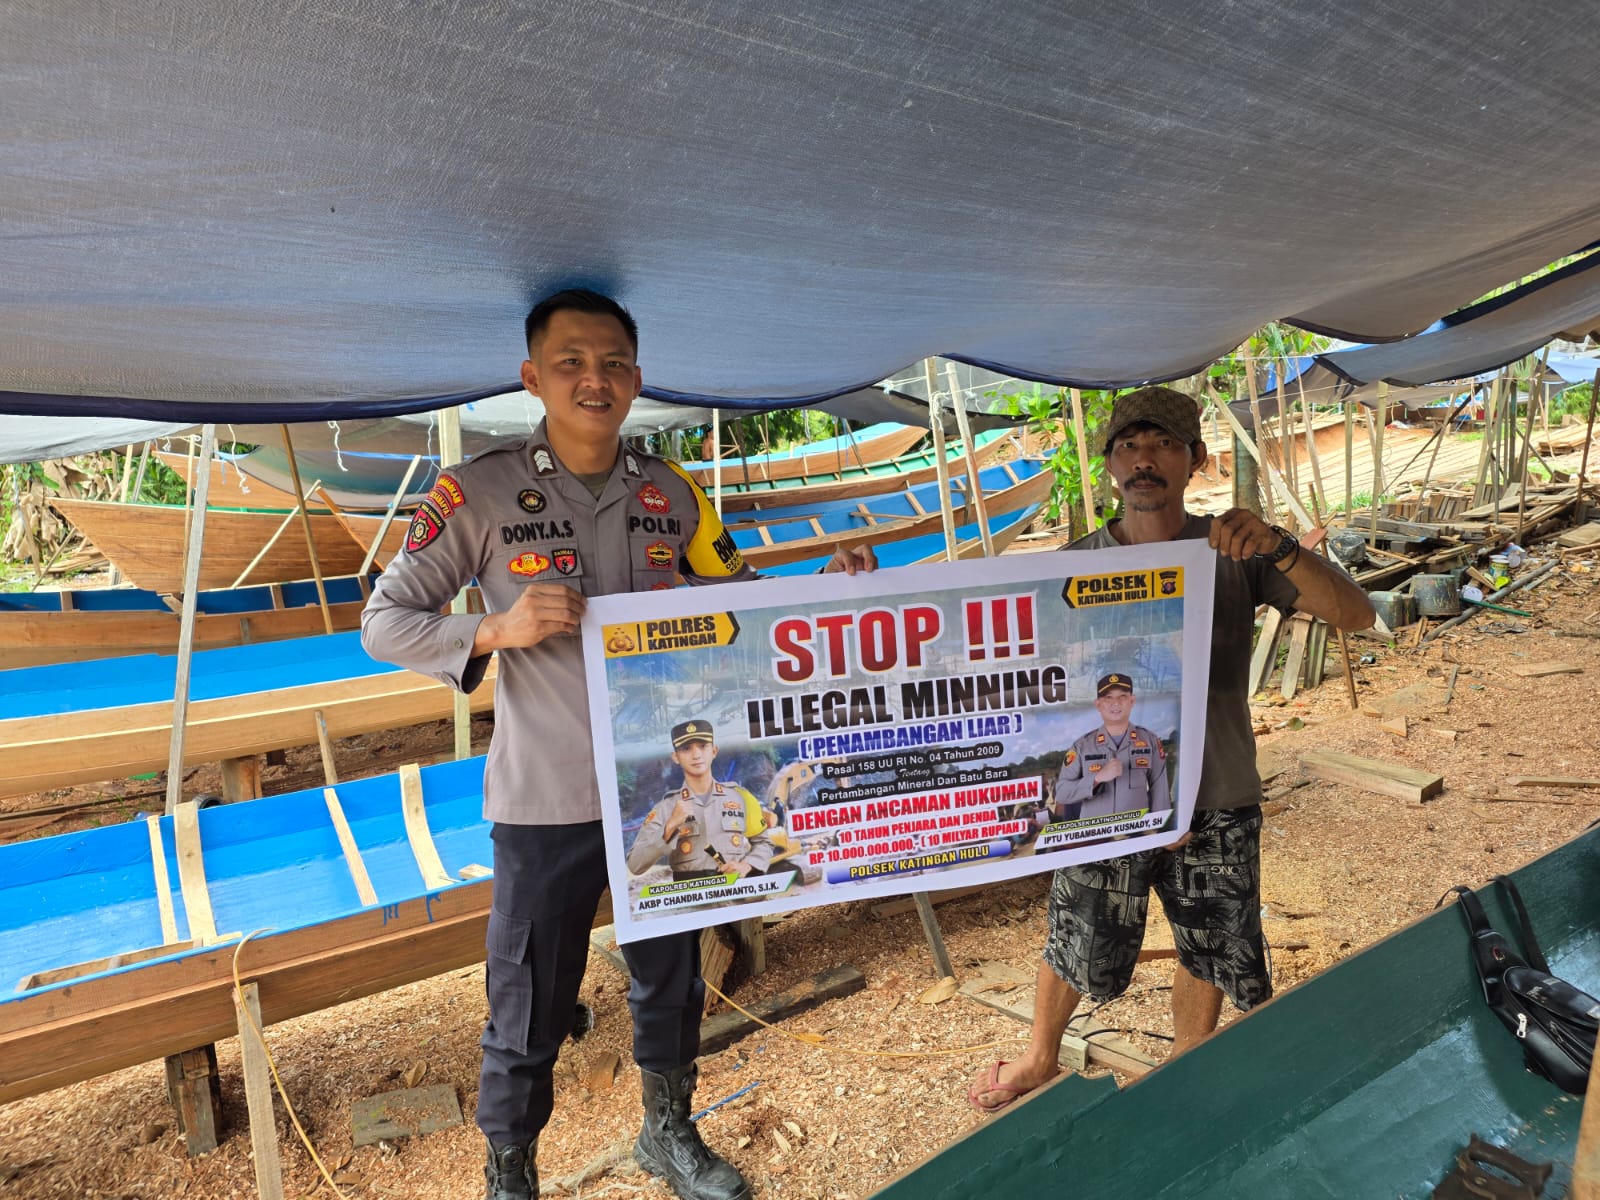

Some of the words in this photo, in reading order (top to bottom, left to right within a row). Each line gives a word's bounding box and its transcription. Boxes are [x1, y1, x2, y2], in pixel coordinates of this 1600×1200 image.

[501, 519, 574, 545] DONY.A.S
[629, 515, 680, 536] POLRI
[1077, 574, 1147, 594] POLSEK
[1077, 591, 1122, 606] KATINGAN
[1124, 589, 1148, 600] HULU
[646, 615, 716, 638] POLRES
[773, 606, 942, 684] STOP
[965, 595, 1036, 662] !!!
[647, 632, 718, 651] KATINGAN
[746, 686, 894, 738] ILLEGAL
[900, 665, 1067, 720] MINNING
[826, 763, 855, 776] Pasal
[858, 761, 876, 772] 158
[878, 758, 893, 769] UU
[896, 756, 907, 766] RI
[909, 754, 927, 764] No.
[929, 753, 942, 762] 04
[944, 749, 975, 760] Tahun
[976, 745, 1000, 757] 2009
[899, 767, 931, 778] Tentang
[821, 783, 895, 802] Pertambangan
[897, 776, 935, 792] Mineral
[937, 775, 957, 786] Dan
[960, 771, 983, 783] Batu
[985, 769, 1008, 779] Bara
[791, 805, 862, 832] DENGAN
[866, 793, 951, 821] ANCAMAN
[954, 780, 1039, 808] HUKUMAN
[839, 831, 852, 844] 10
[854, 825, 890, 841] TAHUN
[892, 818, 937, 836] PENJARA
[938, 814, 960, 829] DAN
[962, 809, 997, 825] DENDA
[1043, 836, 1063, 845] IPTU
[1064, 827, 1113, 841] YUBAMBANG
[1113, 819, 1152, 834] KUSNADY,
[1152, 816, 1164, 826] SH
[1057, 820, 1091, 831] KAPOLSEK
[1091, 814, 1124, 826] KATINGAN
[1123, 811, 1141, 820] HULU
[809, 852, 826, 865] RP.
[942, 830, 979, 844] MILYAR
[850, 861, 897, 879] POLSEK
[898, 850, 957, 870] KATINGAN
[959, 845, 990, 860] HULU
[638, 900, 662, 911] AKBP
[663, 893, 704, 906] CHANDRA
[704, 885, 757, 901] ISMAWANTO,
[757, 881, 780, 893] S.I.K.
[649, 881, 689, 895] KAPOLRES
[689, 876, 727, 889] KATINGAN
